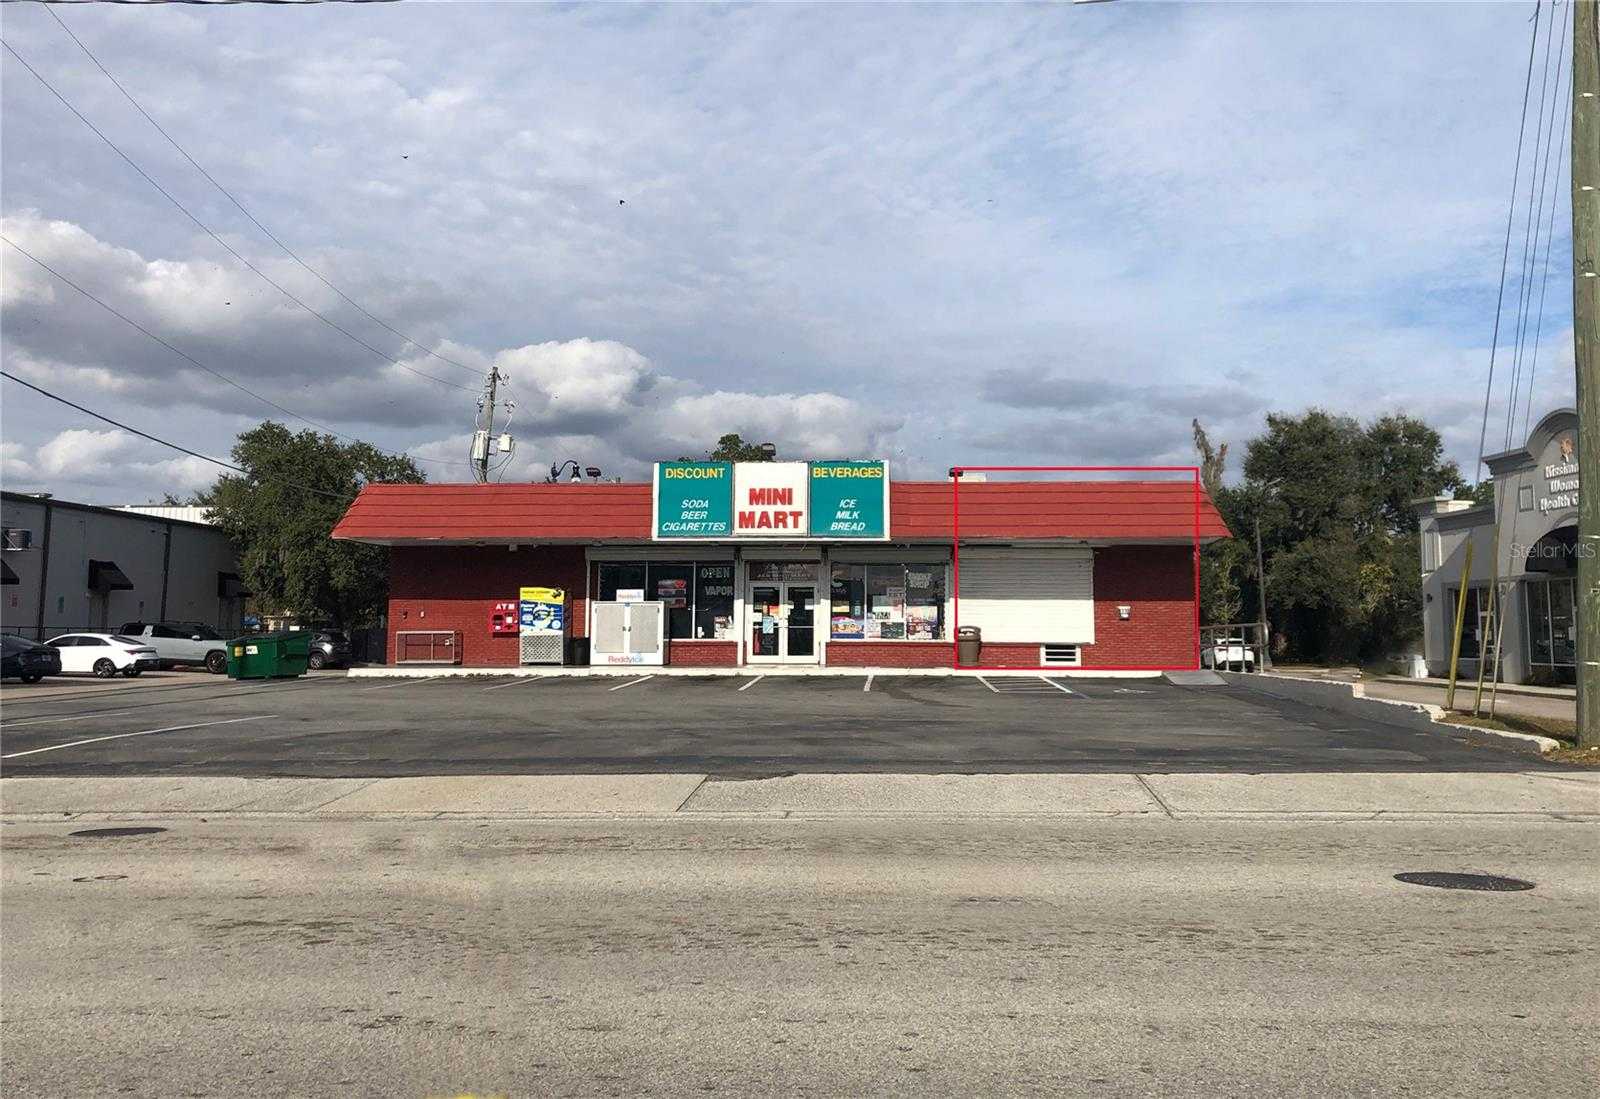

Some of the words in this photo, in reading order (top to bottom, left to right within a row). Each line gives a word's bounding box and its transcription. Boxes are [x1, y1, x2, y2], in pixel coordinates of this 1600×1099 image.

[665, 467, 725, 479] DISCOUNT
[813, 467, 882, 478] BEVERAGES
[749, 488, 793, 505] MINI
[681, 499, 709, 508] SODA
[839, 499, 857, 508] ICE
[681, 511, 708, 519] BEER
[739, 511, 803, 528] MART
[835, 511, 861, 519] MILK
[662, 522, 726, 531] CIGARETTES
[830, 522, 866, 531] BREAD
[701, 567, 730, 578] OPEN
[705, 586, 733, 596] VAPOR
